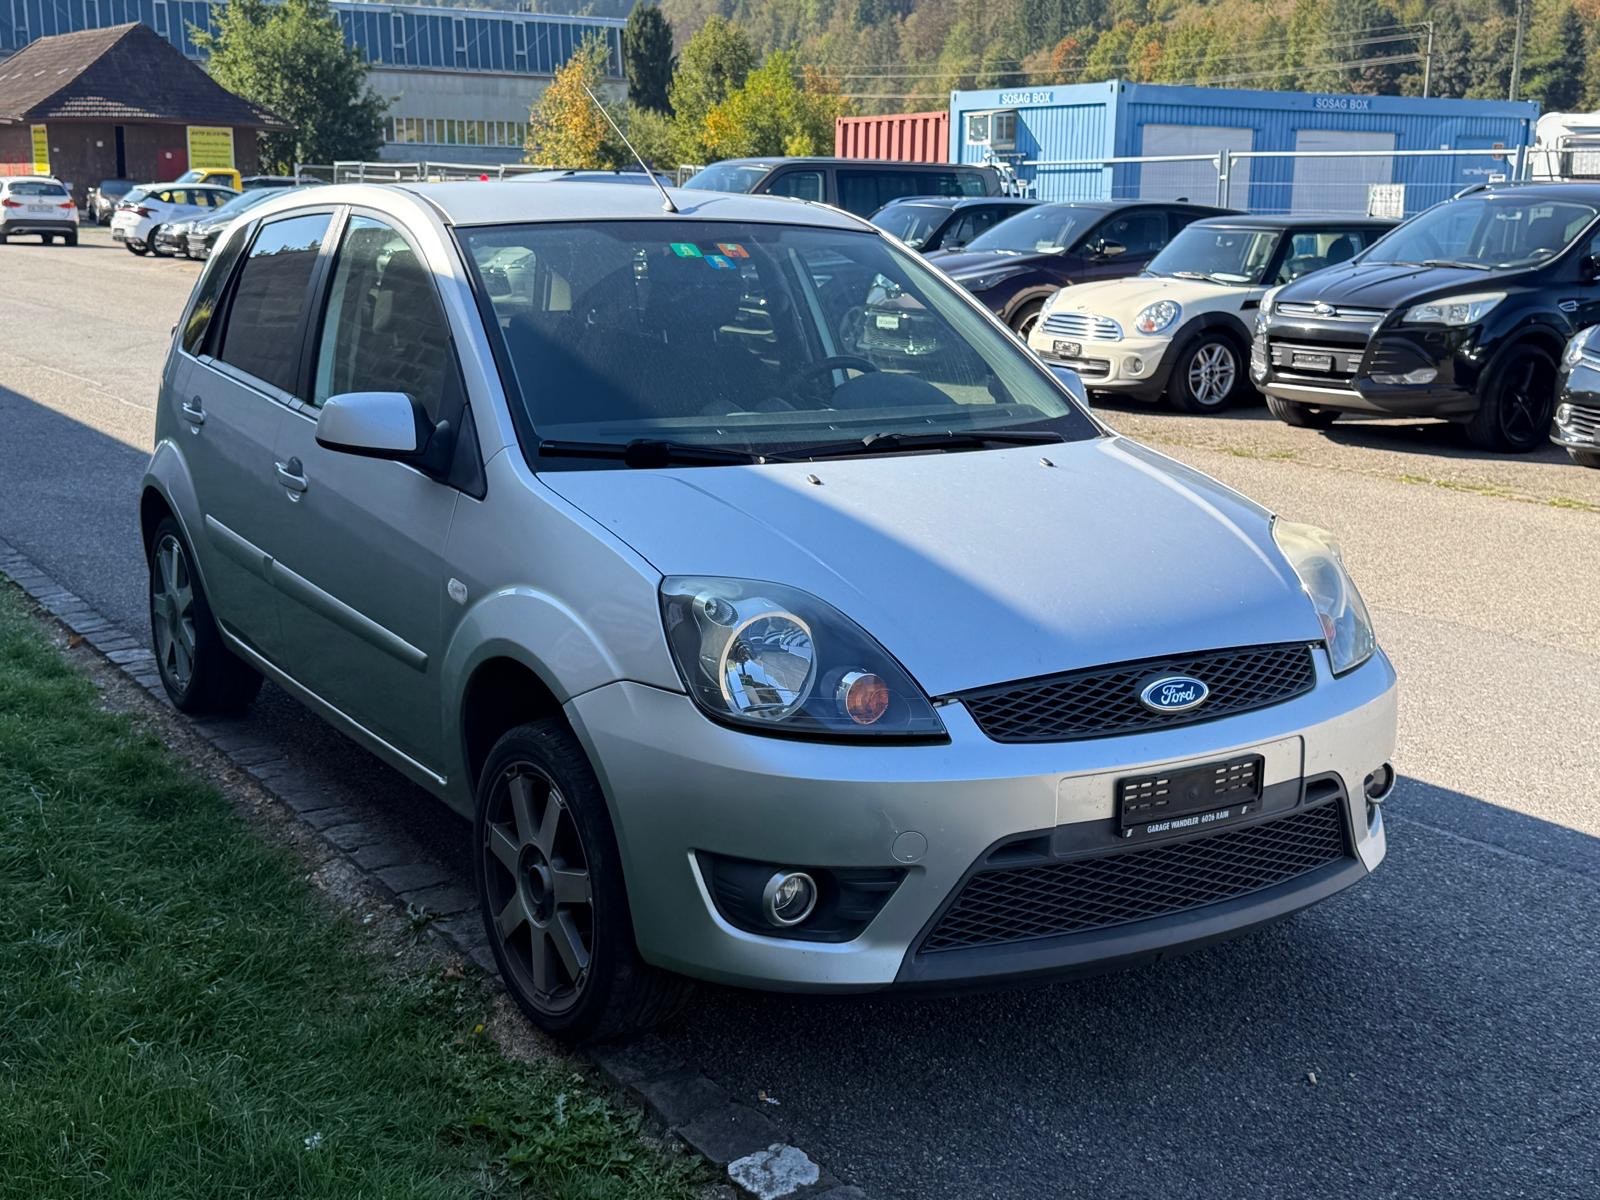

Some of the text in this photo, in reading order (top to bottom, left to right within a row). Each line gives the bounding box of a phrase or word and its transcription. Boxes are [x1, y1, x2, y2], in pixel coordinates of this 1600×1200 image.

[1001, 92, 1050, 105] SOSAG BOX
[1315, 97, 1369, 111] SOSAG BOX
[1160, 683, 1196, 705] Ford
[1147, 810, 1230, 834] GARAGE WANDELER 6026 RAIN
